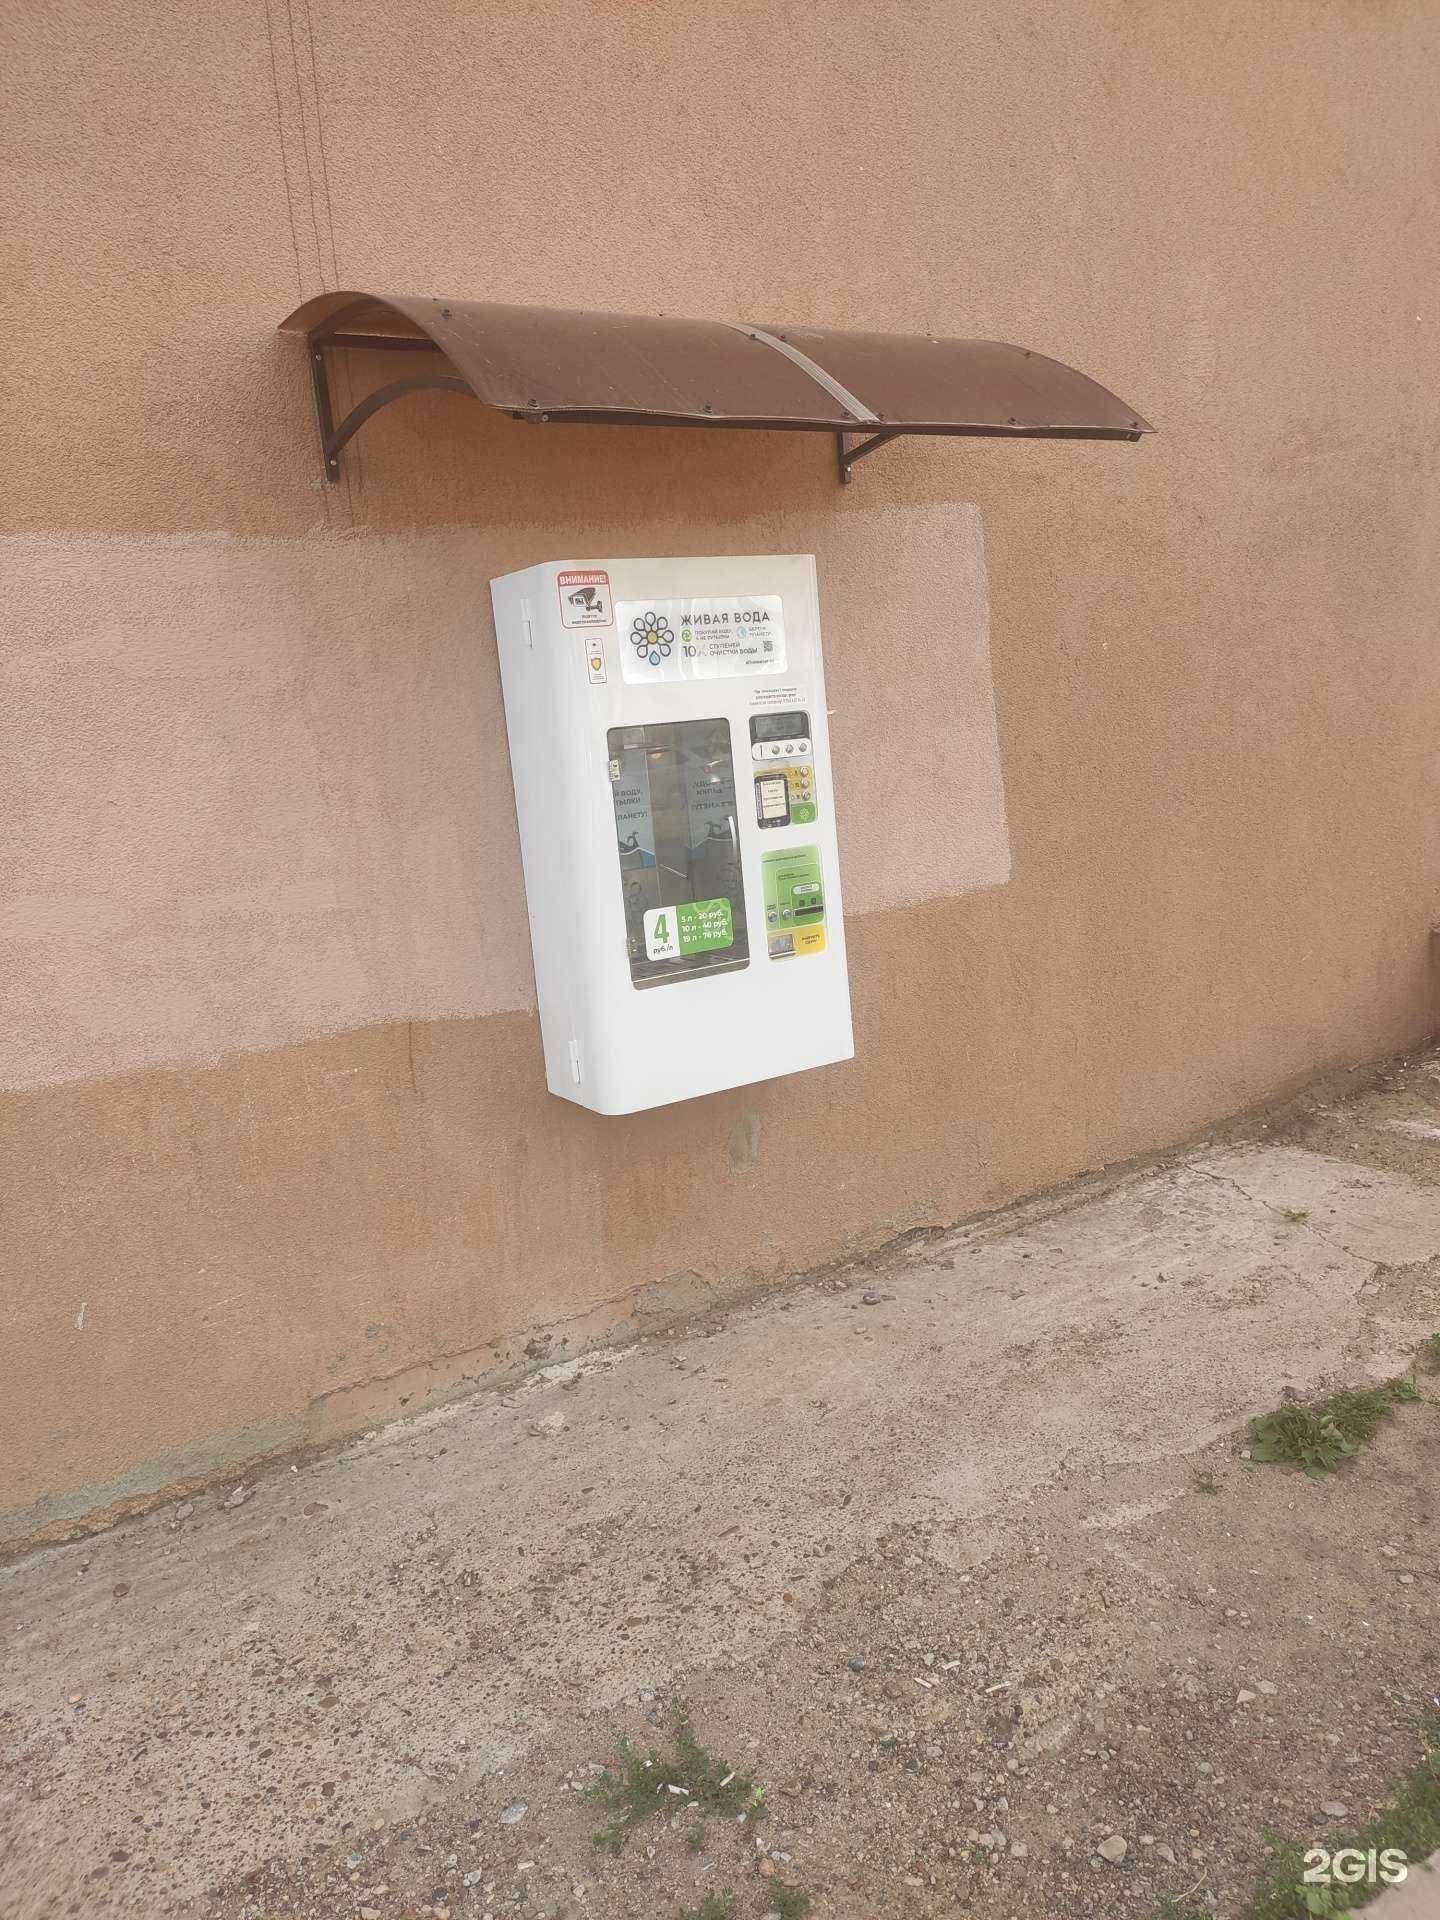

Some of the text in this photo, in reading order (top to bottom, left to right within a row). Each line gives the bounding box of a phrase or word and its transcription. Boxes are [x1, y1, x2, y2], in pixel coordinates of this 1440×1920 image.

[560, 574, 606, 585] ВНИМАНИЕ!
[680, 611, 770, 626] ЖИВАЯ ВОДА
[709, 647, 758, 656] ОЧИСТКИ ВОДЫ
[653, 913, 669, 943] 4
[682, 935, 690, 943] 19
